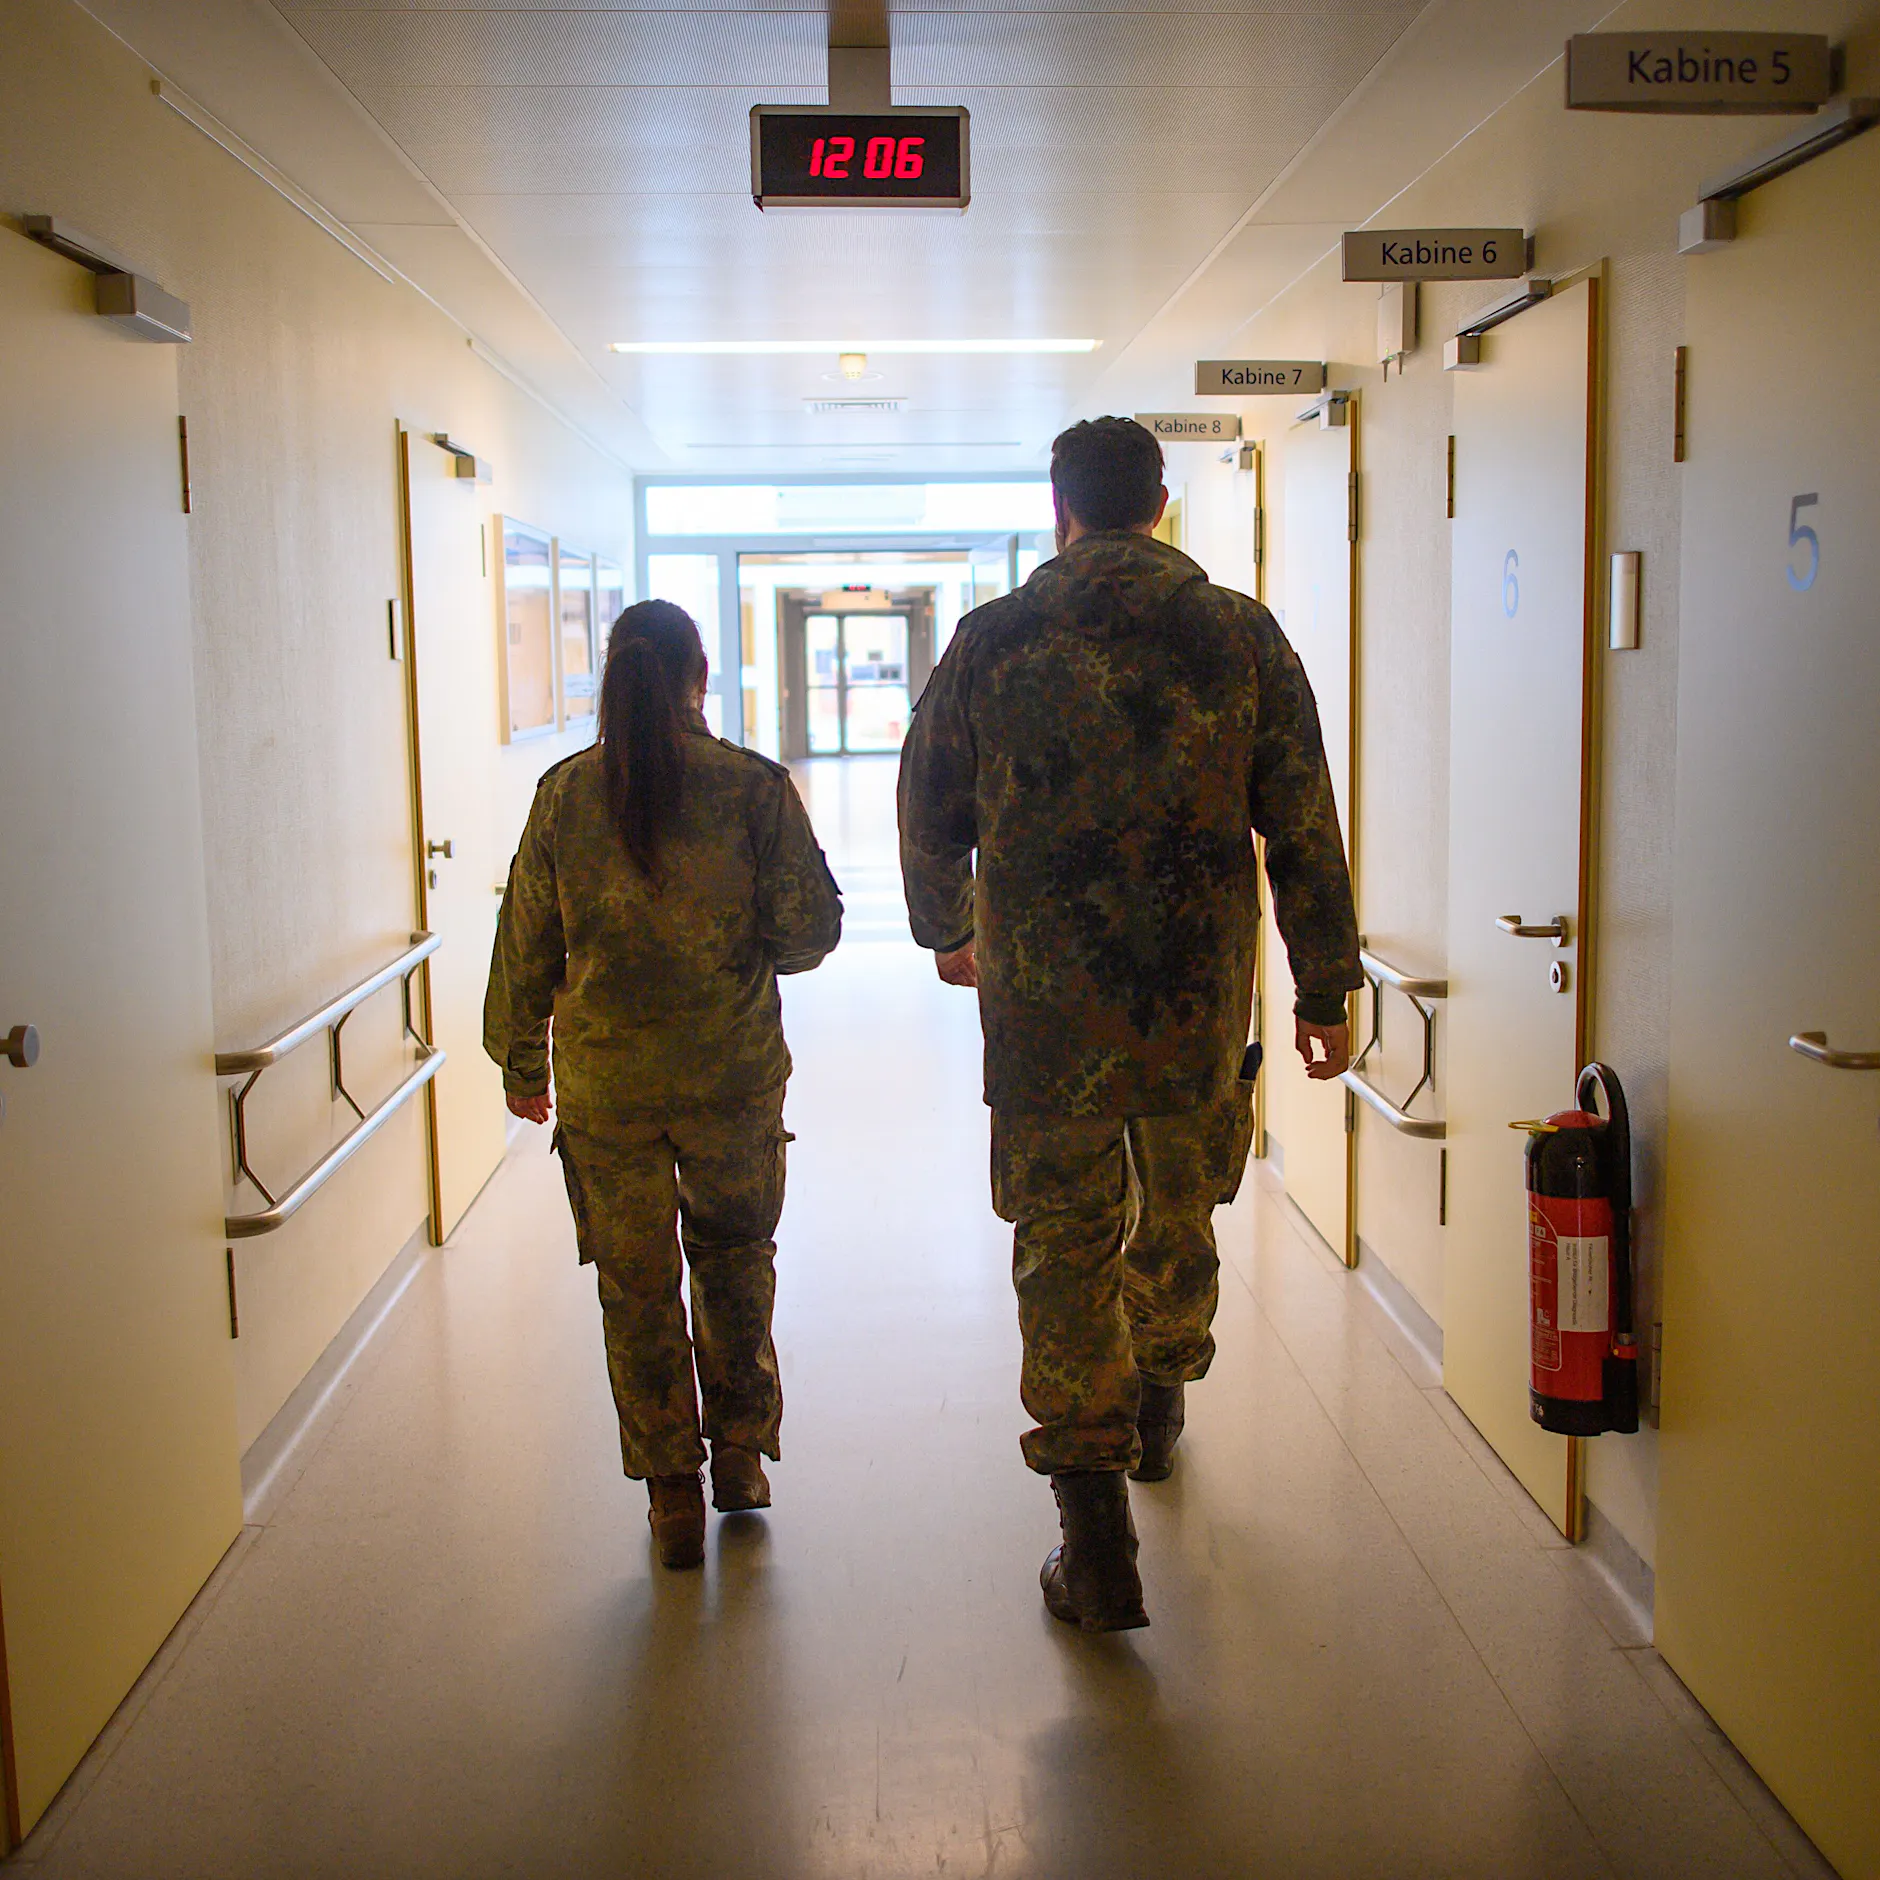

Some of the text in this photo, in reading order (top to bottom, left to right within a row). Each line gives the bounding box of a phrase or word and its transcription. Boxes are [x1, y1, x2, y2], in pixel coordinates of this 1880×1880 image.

[1629, 47, 1791, 85] Kabine 5
[809, 136, 925, 179] 12 06
[1382, 240, 1497, 266] Kabine 6
[1222, 367, 1303, 385] Kabine 7
[1154, 418, 1222, 434] Kabine 8
[1786, 491, 1820, 592] 5
[1501, 548, 1520, 620] 6
